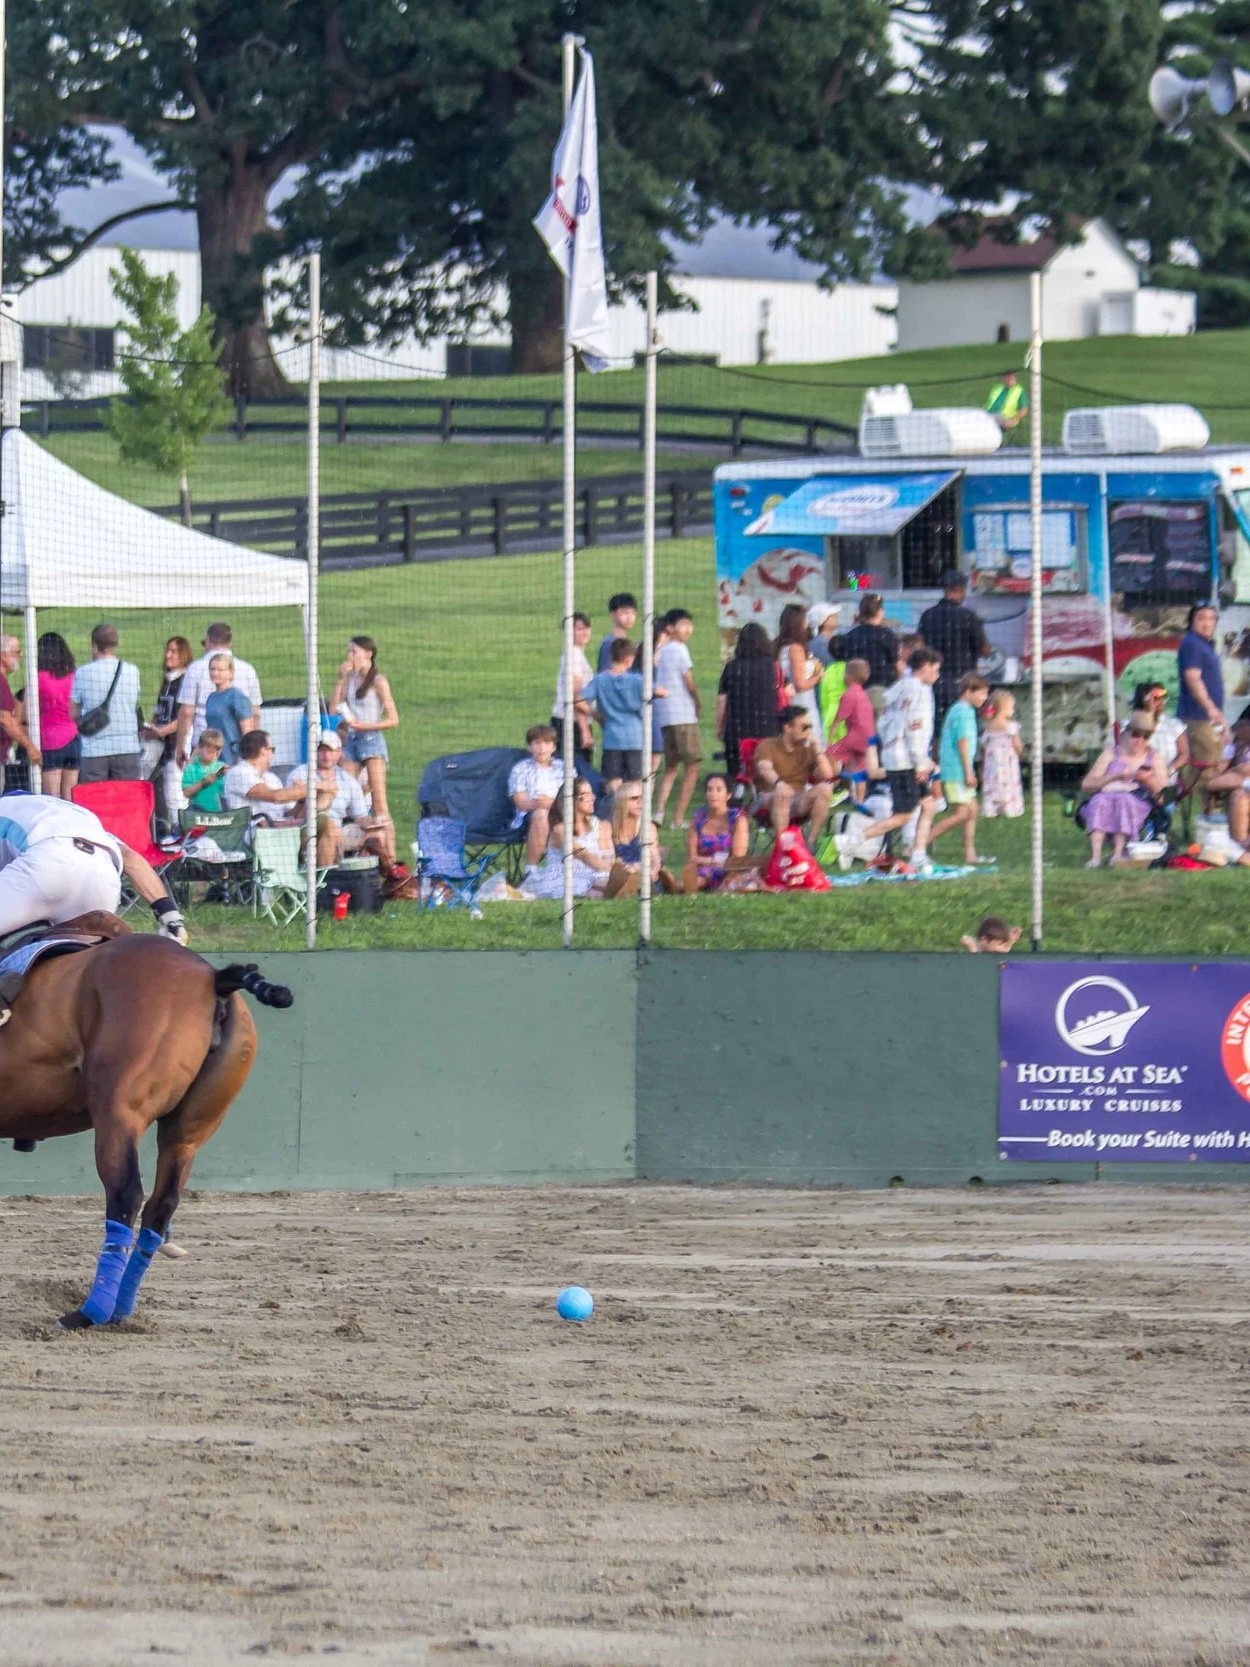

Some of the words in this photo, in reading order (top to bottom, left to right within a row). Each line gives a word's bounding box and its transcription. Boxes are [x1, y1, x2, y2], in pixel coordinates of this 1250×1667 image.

[1017, 1063, 1105, 1084] HOTELS
[1109, 1067, 1138, 1083] AT
[1020, 1099, 1093, 1112] LUXURY
[1104, 1099, 1182, 1112] CRUISES
[1047, 1129, 1096, 1148] Book
[1098, 1133, 1142, 1151] your
[1143, 1130, 1191, 1148] Suite
[1193, 1131, 1234, 1148] with
